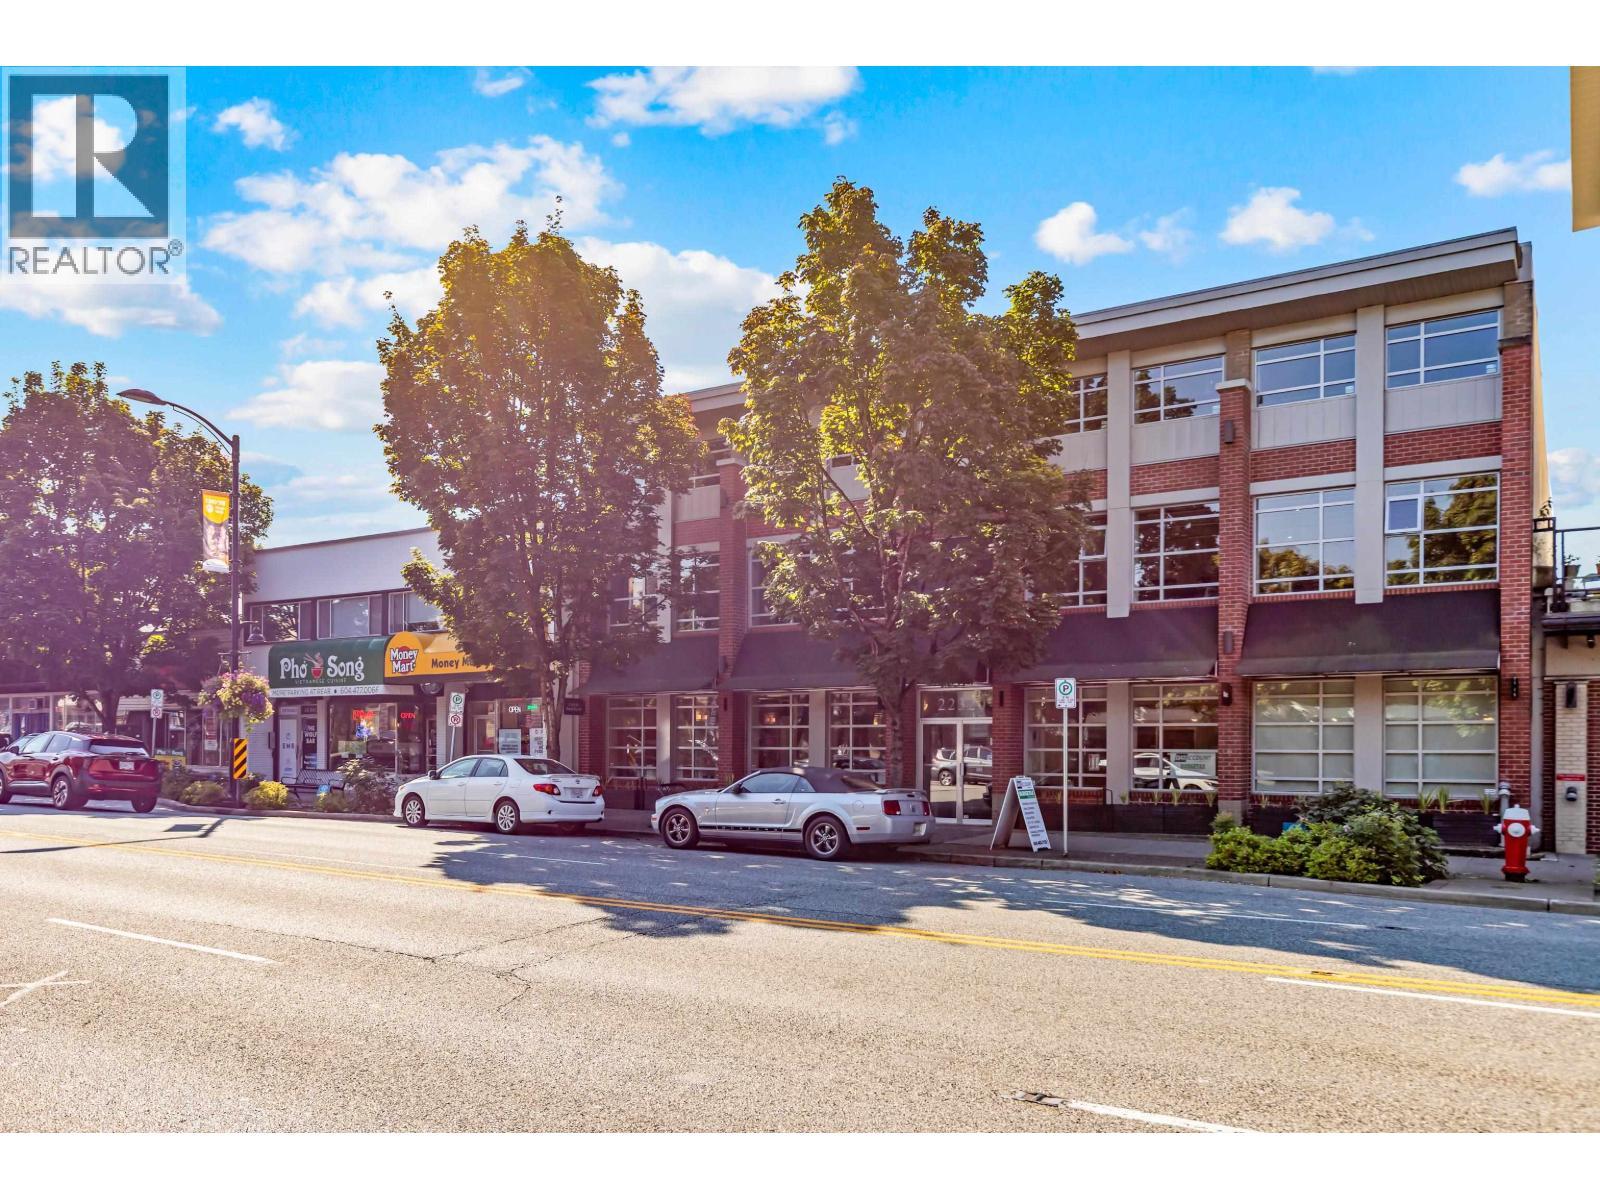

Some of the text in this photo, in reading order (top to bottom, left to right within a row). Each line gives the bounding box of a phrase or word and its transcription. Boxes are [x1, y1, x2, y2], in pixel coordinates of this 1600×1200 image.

[390, 648, 419, 662] Money
[326, 655, 365, 682] Song
[392, 660, 416, 674] Mart
[431, 658, 459, 669] Money
[287, 688, 309, 696] PARKING
[508, 705, 521, 713] OPEN
